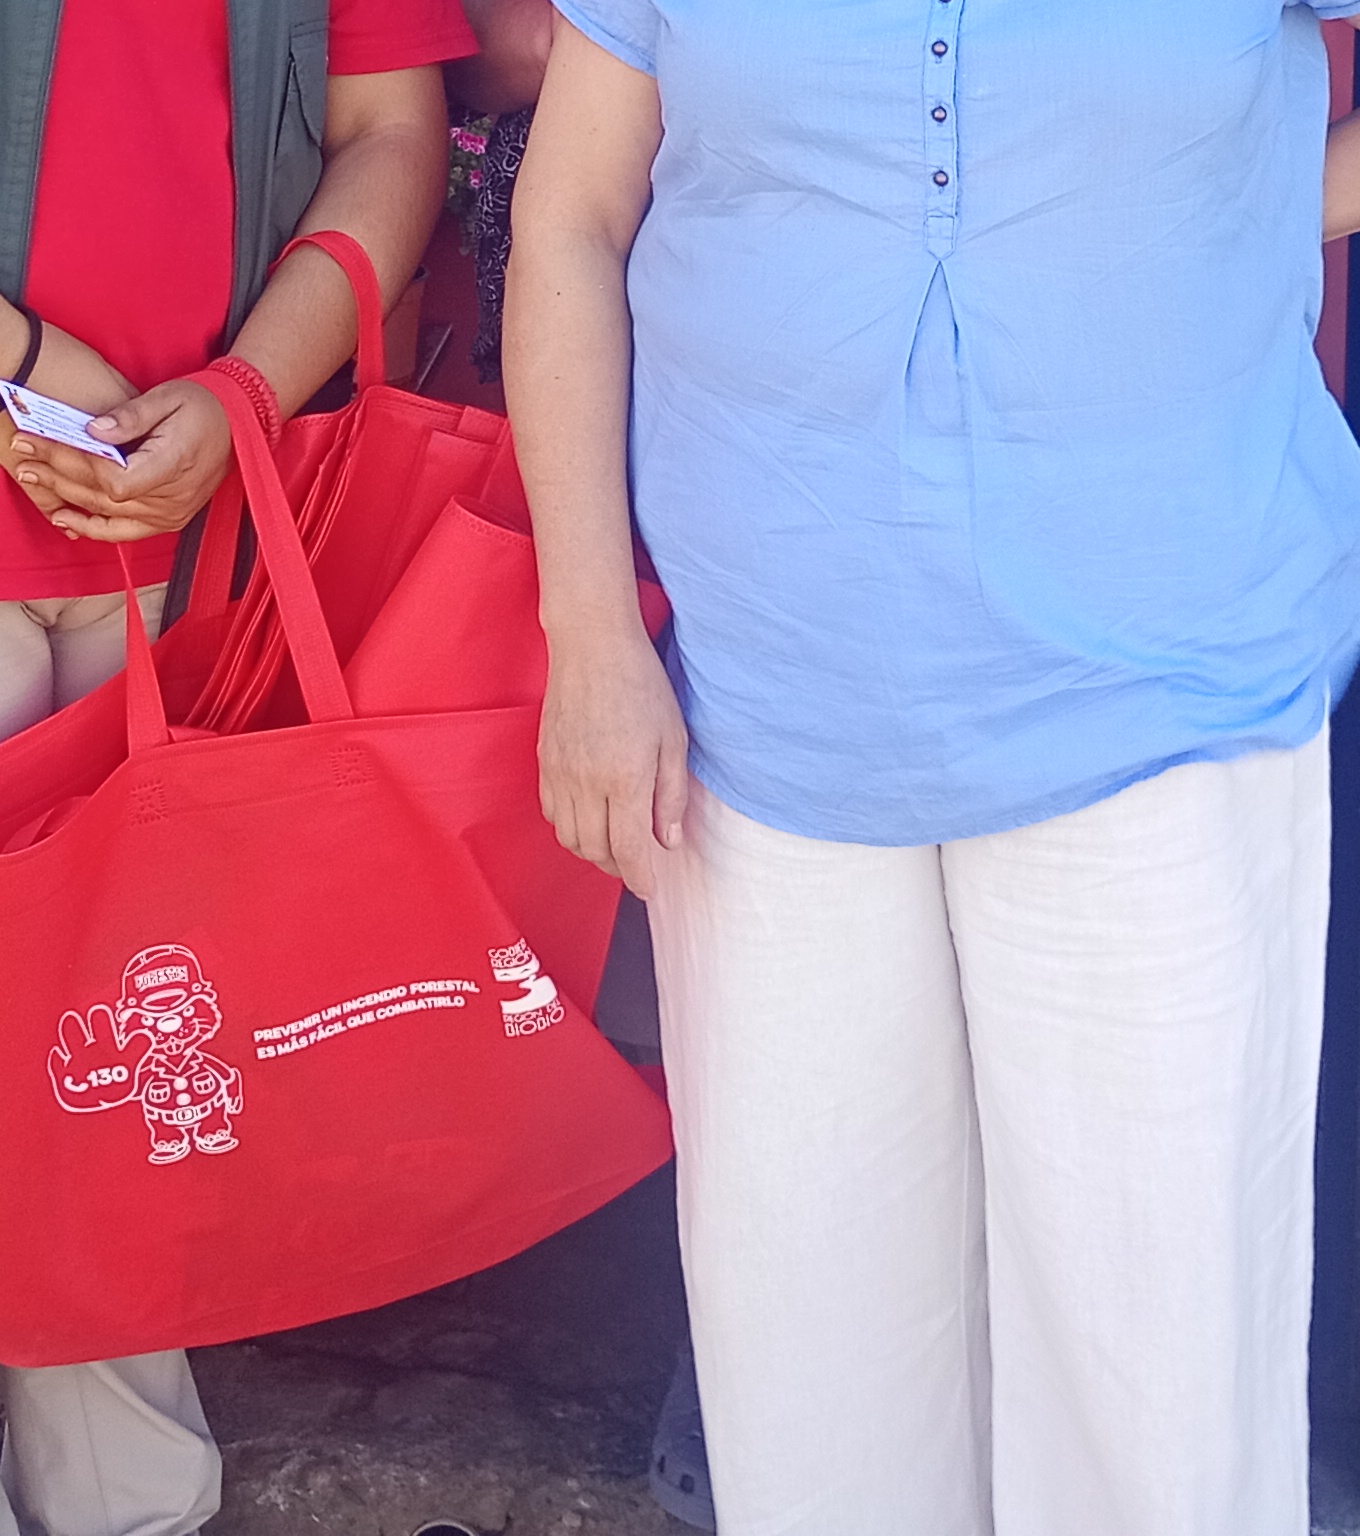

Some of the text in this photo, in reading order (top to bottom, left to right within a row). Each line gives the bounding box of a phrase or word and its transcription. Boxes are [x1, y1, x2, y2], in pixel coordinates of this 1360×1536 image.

[254, 980, 480, 1042] PREVENIR UN INCENDIO FORESTAL
[256, 995, 465, 1060] ES MÁS FÁCIL QUE COMBATIRLO
[87, 1066, 128, 1087] 130
